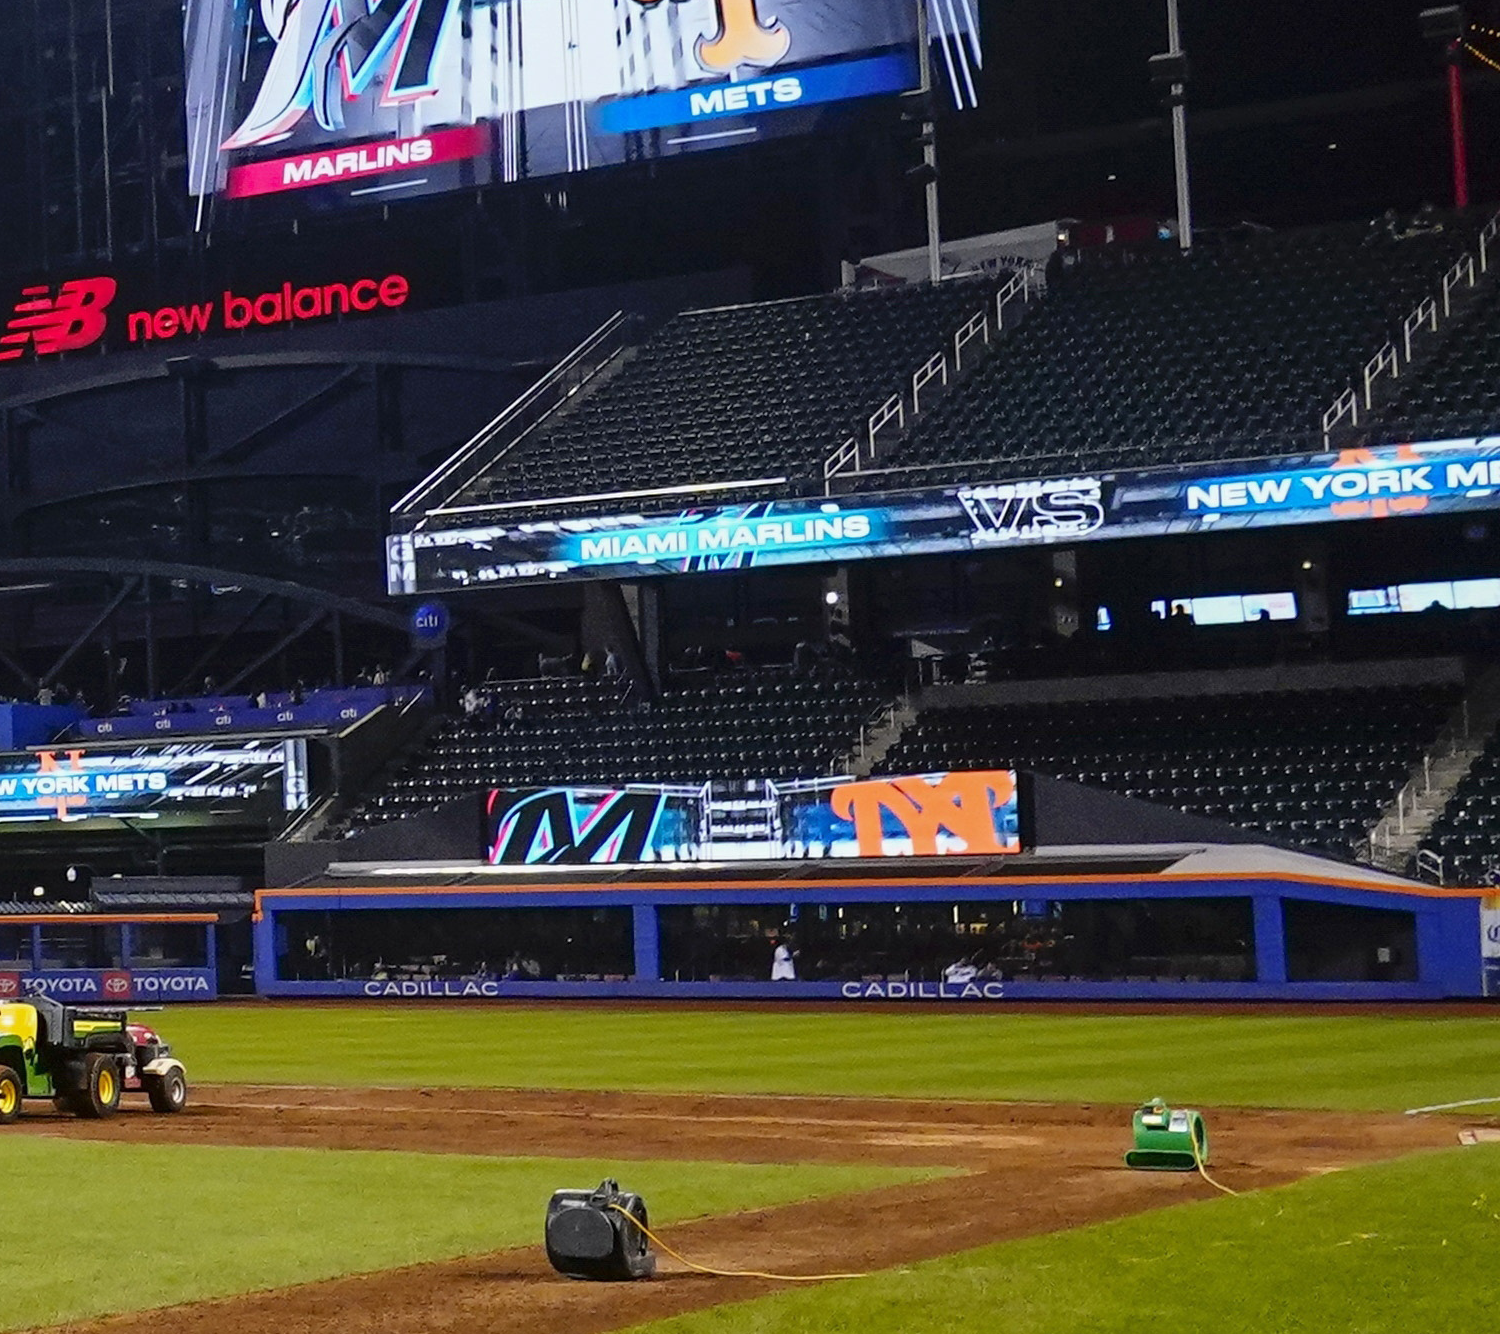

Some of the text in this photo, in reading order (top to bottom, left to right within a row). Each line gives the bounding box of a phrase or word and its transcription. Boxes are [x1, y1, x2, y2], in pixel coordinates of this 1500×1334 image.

[690, 78, 802, 116] METS
[282, 139, 433, 184] MARLINS
[129, 275, 409, 343] new balance
[581, 531, 688, 560] MIAMI
[698, 515, 871, 550] MARLINS
[957, 477, 1105, 542] VS
[1187, 476, 1292, 510] NEW
[1301, 463, 1434, 500] YORK
[22, 775, 92, 795] YORK
[95, 772, 167, 791] METS
[21, 977, 209, 992] TOYOTA TOYOTA
[364, 980, 500, 997] CADILLAC
[841, 980, 1005, 998] CADILLAC
